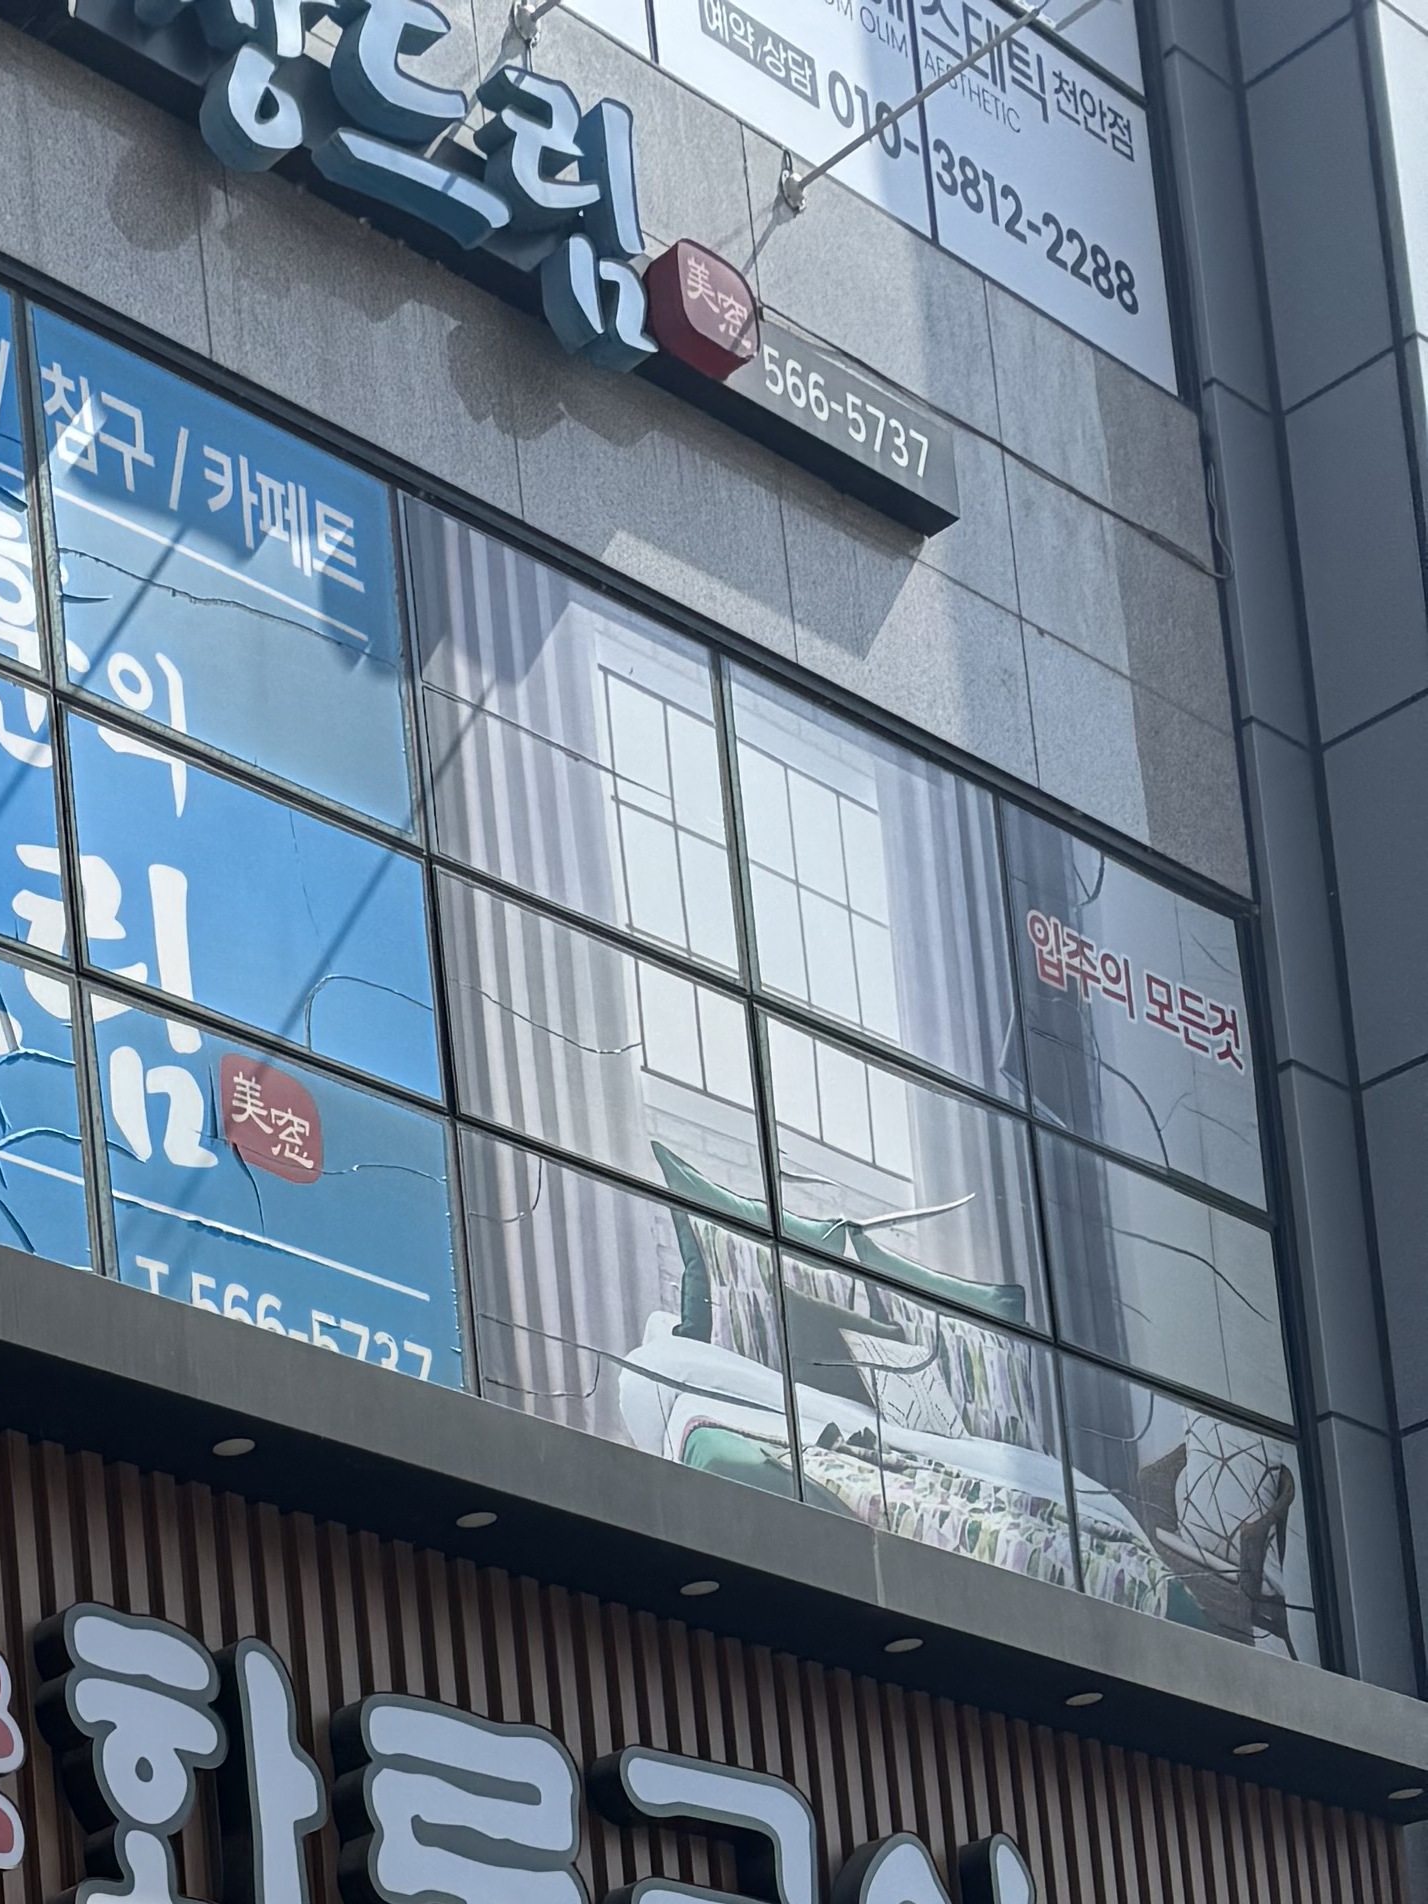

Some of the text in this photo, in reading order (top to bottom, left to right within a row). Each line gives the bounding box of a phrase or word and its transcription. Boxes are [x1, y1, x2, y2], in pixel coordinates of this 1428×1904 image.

[860, 6, 908, 58] OLIM
[1052, 69, 1135, 163] 천안점
[828, 69, 1140, 316] 010-3812-2288
[41, 361, 154, 492] 침구
[202, 454, 365, 593] 카페트
[762, 344, 929, 478] 566-5737
[1027, 909, 1244, 1074] 입주의 모든것
